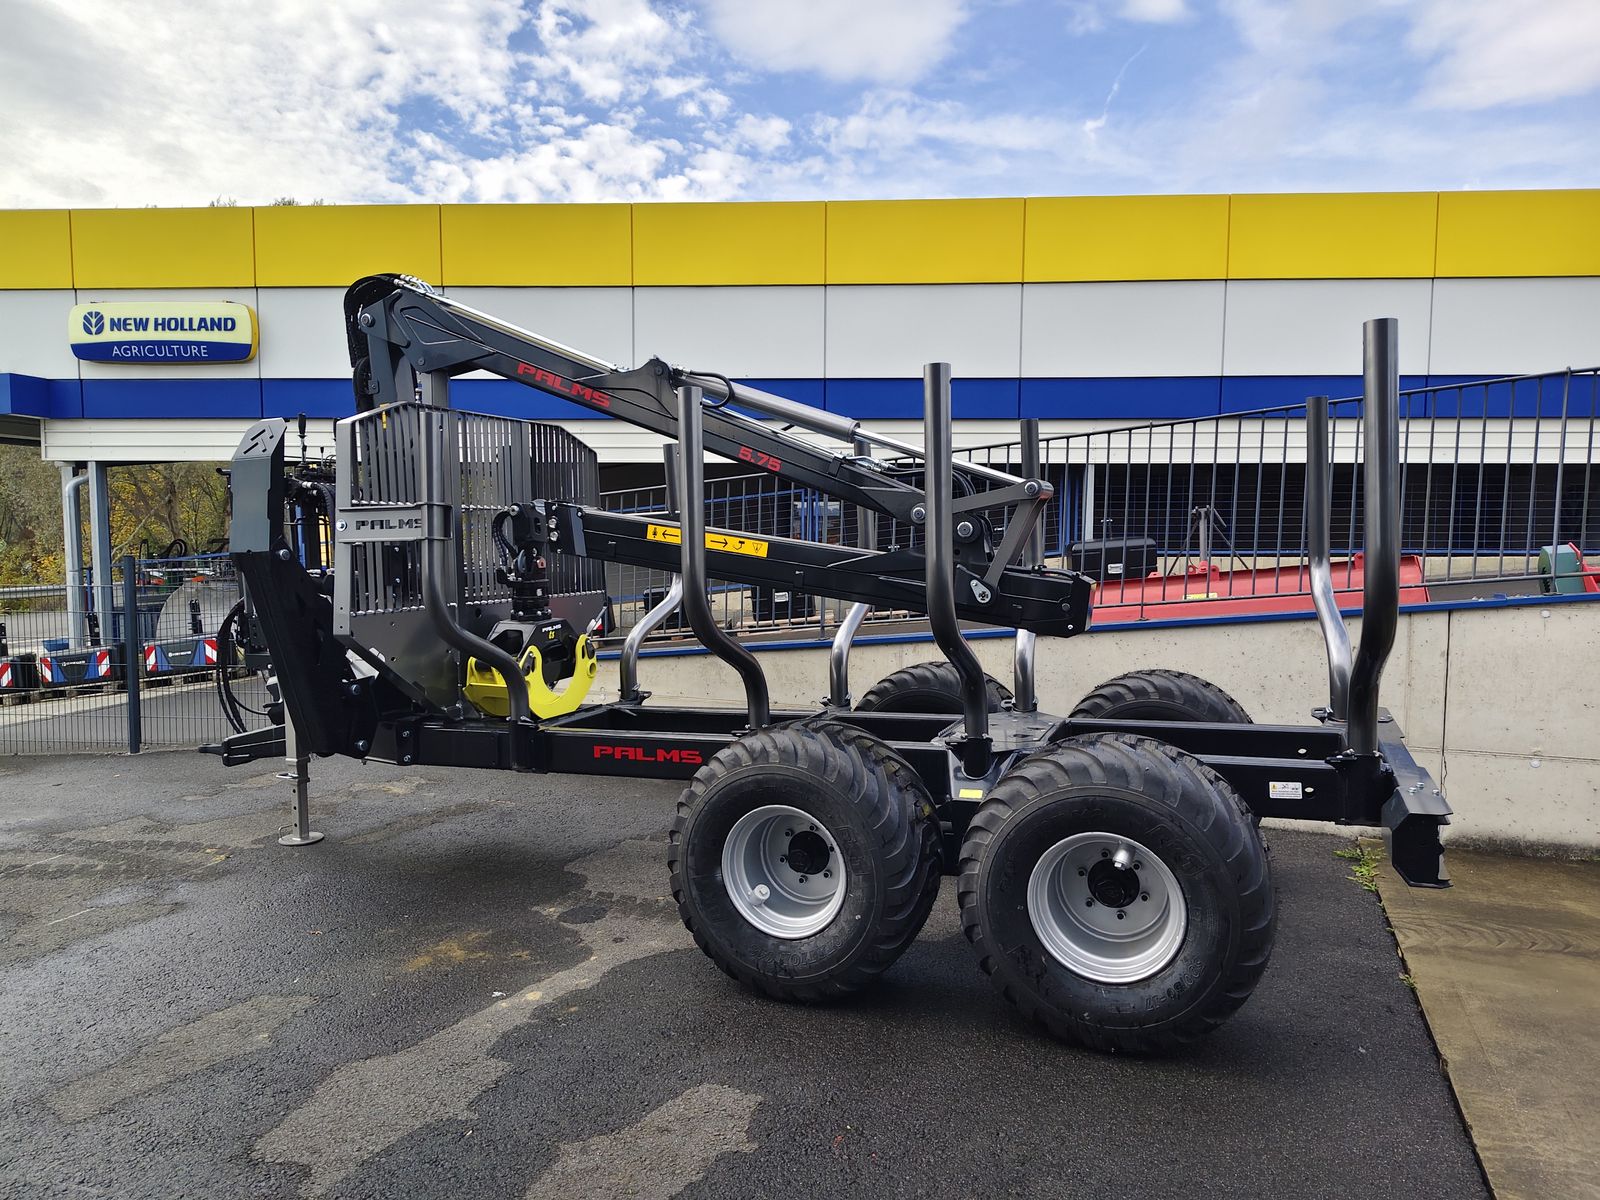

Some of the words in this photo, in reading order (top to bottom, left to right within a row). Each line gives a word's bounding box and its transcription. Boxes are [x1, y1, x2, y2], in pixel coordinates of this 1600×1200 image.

[109, 317, 150, 332] NEW
[153, 317, 236, 332] HOLLAND
[111, 345, 209, 358] AGRICULTURE
[517, 362, 611, 408] PALMS
[738, 446, 782, 472] 5.75
[593, 745, 703, 764] PALMS
